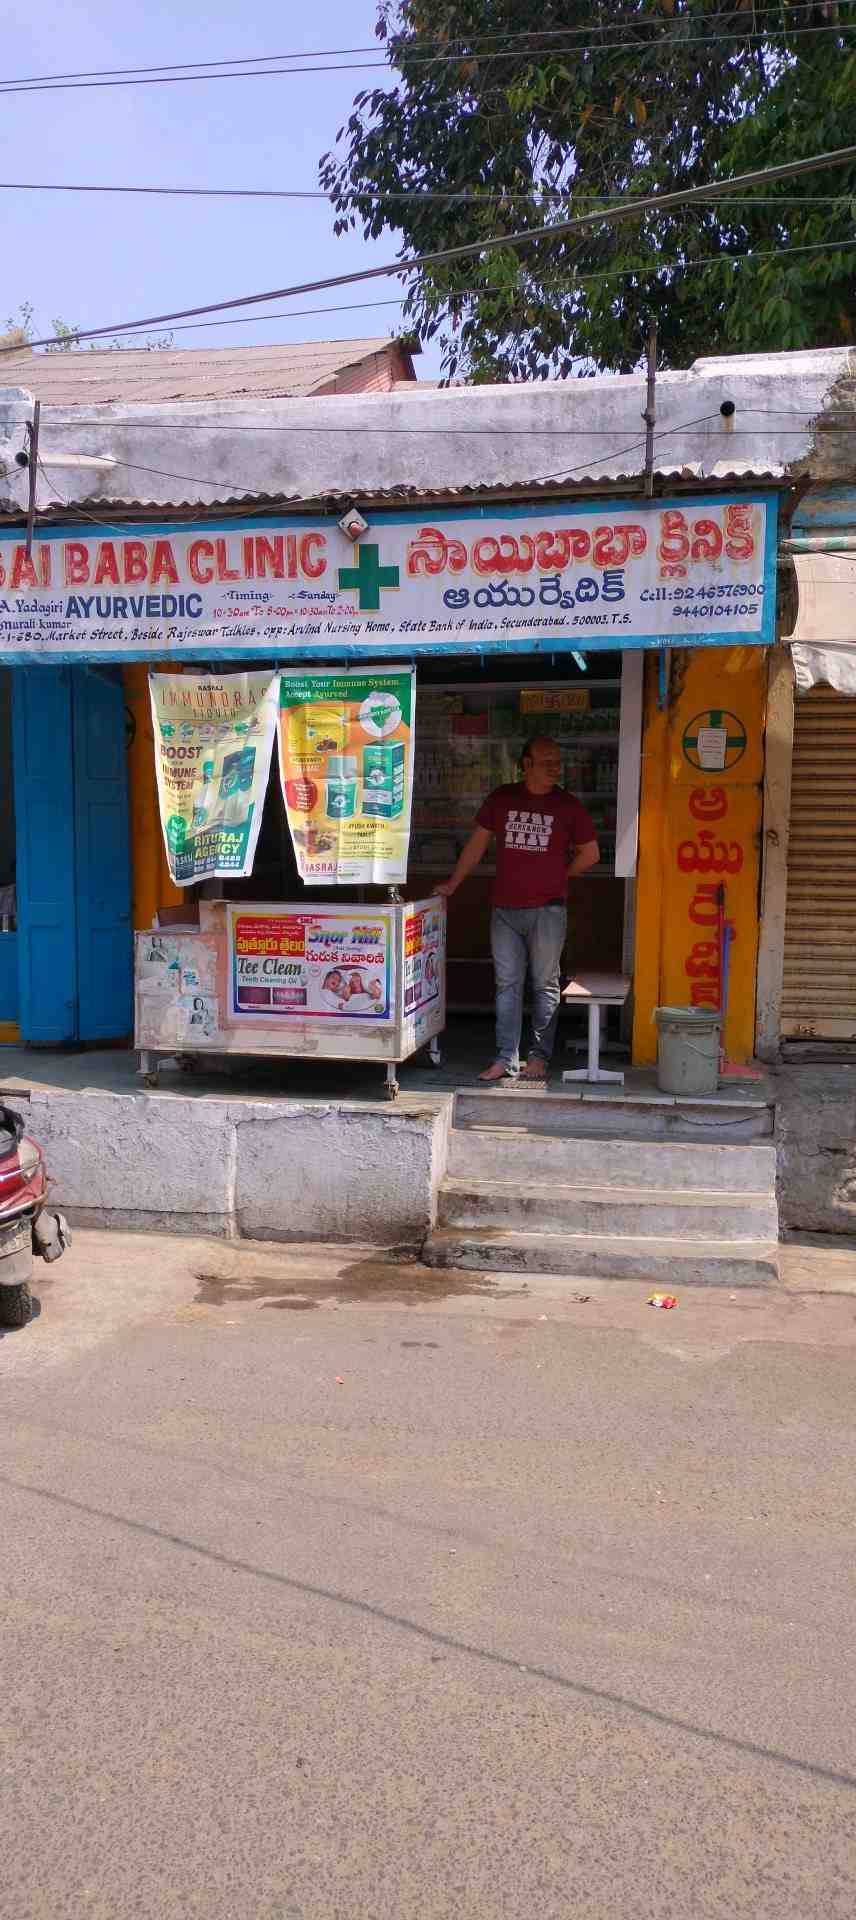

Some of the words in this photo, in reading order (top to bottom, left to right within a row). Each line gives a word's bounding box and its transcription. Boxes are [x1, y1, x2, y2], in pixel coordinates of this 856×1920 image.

[0, 544, 51, 589] AI
[63, 540, 180, 588] BABA
[187, 532, 328, 584] CLINIC
[407, 524, 648, 576] సాయిబాబా
[65, 593, 203, 618] AYURVEDIC
[161, 745, 203, 759] BOOST
[239, 958, 258, 975] Tee
[263, 958, 302, 976] Clean
